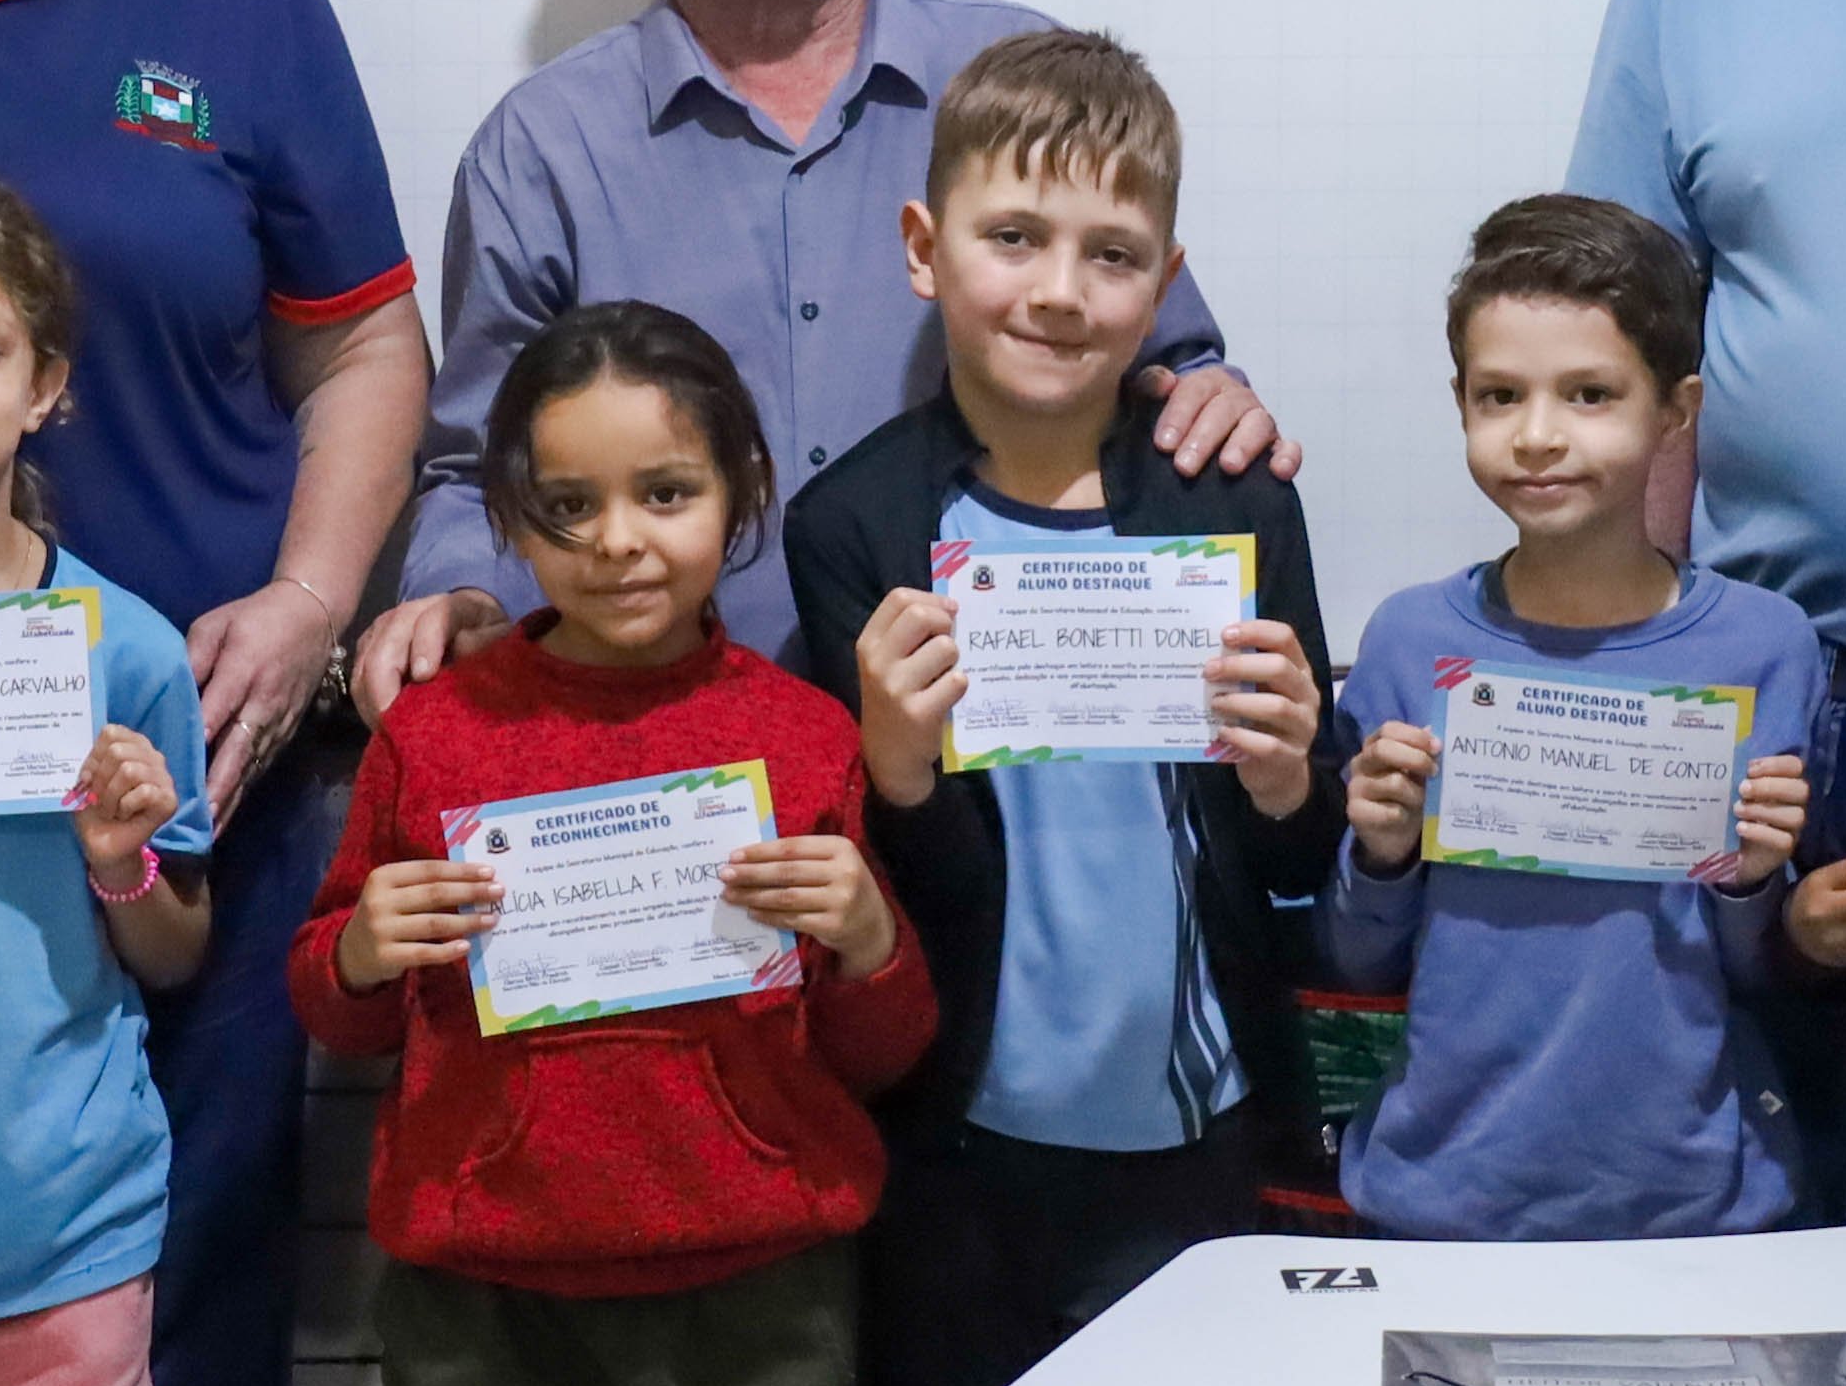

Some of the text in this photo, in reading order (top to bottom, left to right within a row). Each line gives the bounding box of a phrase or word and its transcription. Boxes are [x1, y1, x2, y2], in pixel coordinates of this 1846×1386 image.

[1022, 561, 1147, 575] CERTIFICADO DE
[1017, 577, 1153, 592] ALUNO DESTAQUE
[969, 628, 1045, 651] RAFAEL
[1056, 627, 1143, 649] BONETTI
[0, 674, 86, 696] CARVALHO
[1523, 686, 1645, 712] CERTIFICADO DE
[1516, 702, 1649, 727] ALUNO DESTAQUE
[1451, 735, 1531, 762] ANTONIO
[1541, 747, 1617, 772] MANUEL
[1629, 757, 1653, 776] DE
[1664, 761, 1727, 781] CONTO
[535, 800, 660, 832] CERTIFICADO DE
[530, 816, 671, 849] RECONHECIMENTO
[553, 875, 643, 907] ISABELLA
[675, 860, 733, 887] MORE
